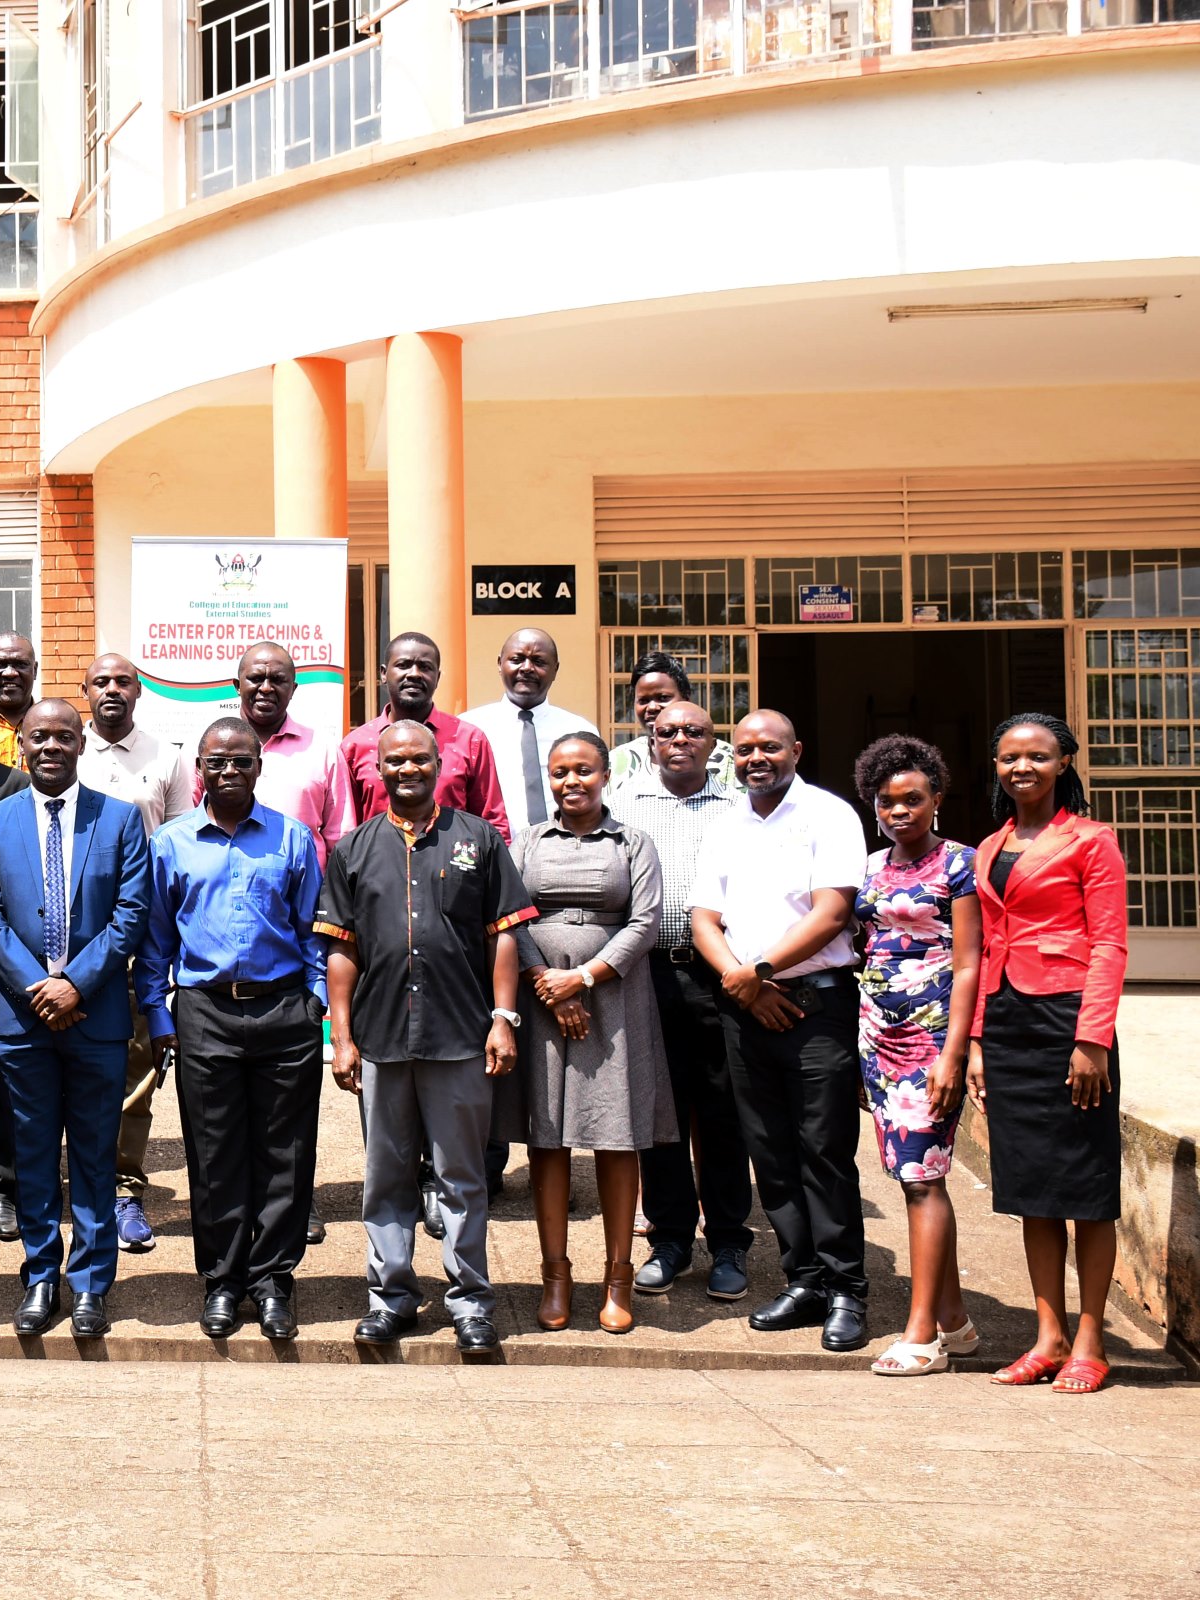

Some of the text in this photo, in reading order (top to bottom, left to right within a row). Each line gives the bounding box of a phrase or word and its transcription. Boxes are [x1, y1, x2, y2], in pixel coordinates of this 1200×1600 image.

[475, 582, 572, 599] BLOCK A
[189, 601, 220, 610] College
[232, 601, 271, 609] Education
[273, 601, 289, 609] and
[206, 610, 271, 618] External Studies
[812, 612, 844, 620] ASSAULT
[148, 623, 323, 640] CENTER FOR TEACHING &
[142, 644, 213, 660] LEARNING
